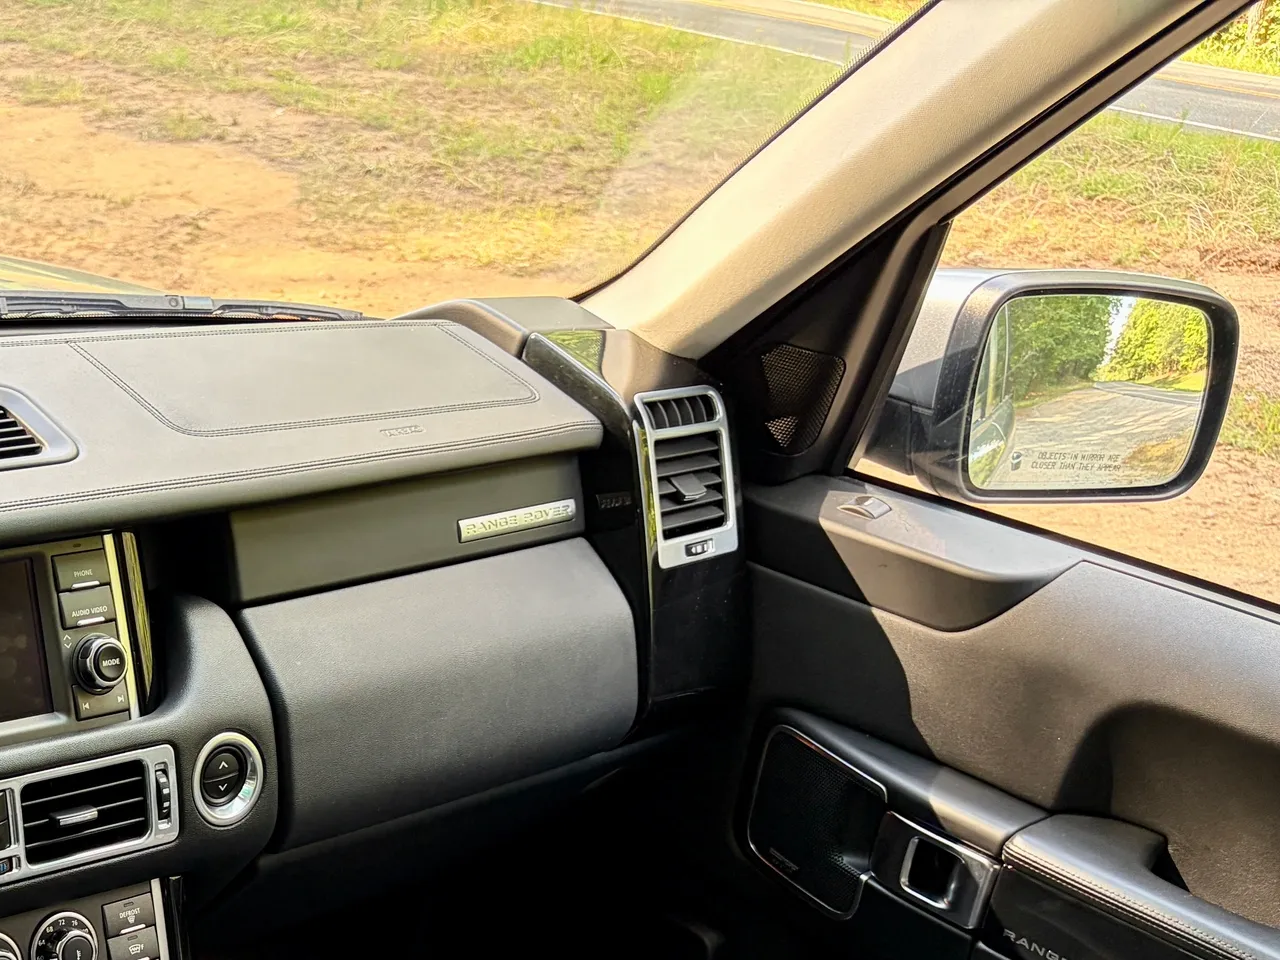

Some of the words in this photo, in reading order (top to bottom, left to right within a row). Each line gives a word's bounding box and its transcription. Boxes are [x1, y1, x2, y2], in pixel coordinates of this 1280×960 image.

[1038, 451, 1067, 460] OBJECTS
[1070, 453, 1079, 461] IN
[1081, 453, 1106, 462] MIRROR
[1107, 454, 1121, 463] ARE
[1031, 461, 1056, 470] CLOSER
[1060, 462, 1076, 471] THAN
[1078, 462, 1095, 471] THEY
[1096, 463, 1122, 472] APPEAR
[466, 515, 518, 535] RANGE
[523, 504, 571, 523] ROVER
[73, 568, 94, 578] PHONE
[71, 607, 91, 618] AUDIO
[91, 605, 108, 614] VIDEO
[102, 658, 121, 667] MODE
[119, 908, 141, 919] DEFROST
